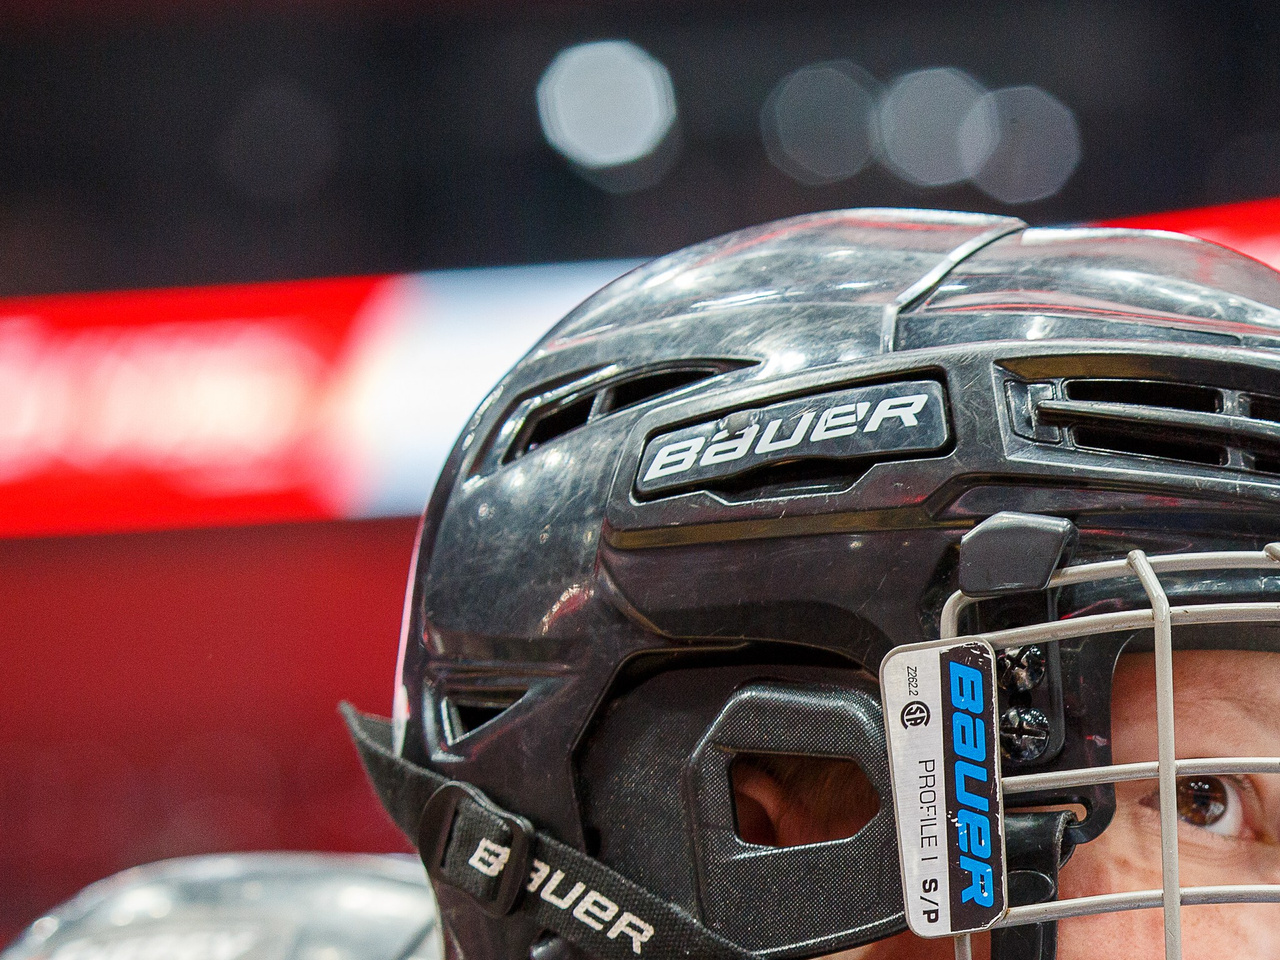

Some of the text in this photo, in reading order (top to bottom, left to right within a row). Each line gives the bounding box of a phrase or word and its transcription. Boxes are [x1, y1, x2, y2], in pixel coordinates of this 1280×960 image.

[643, 394, 929, 482] BAUER
[906, 665, 919, 696] Z262.2
[918, 758, 938, 849] PROFILE
[949, 660, 995, 909] BAUER
[922, 877, 940, 924] S/P
